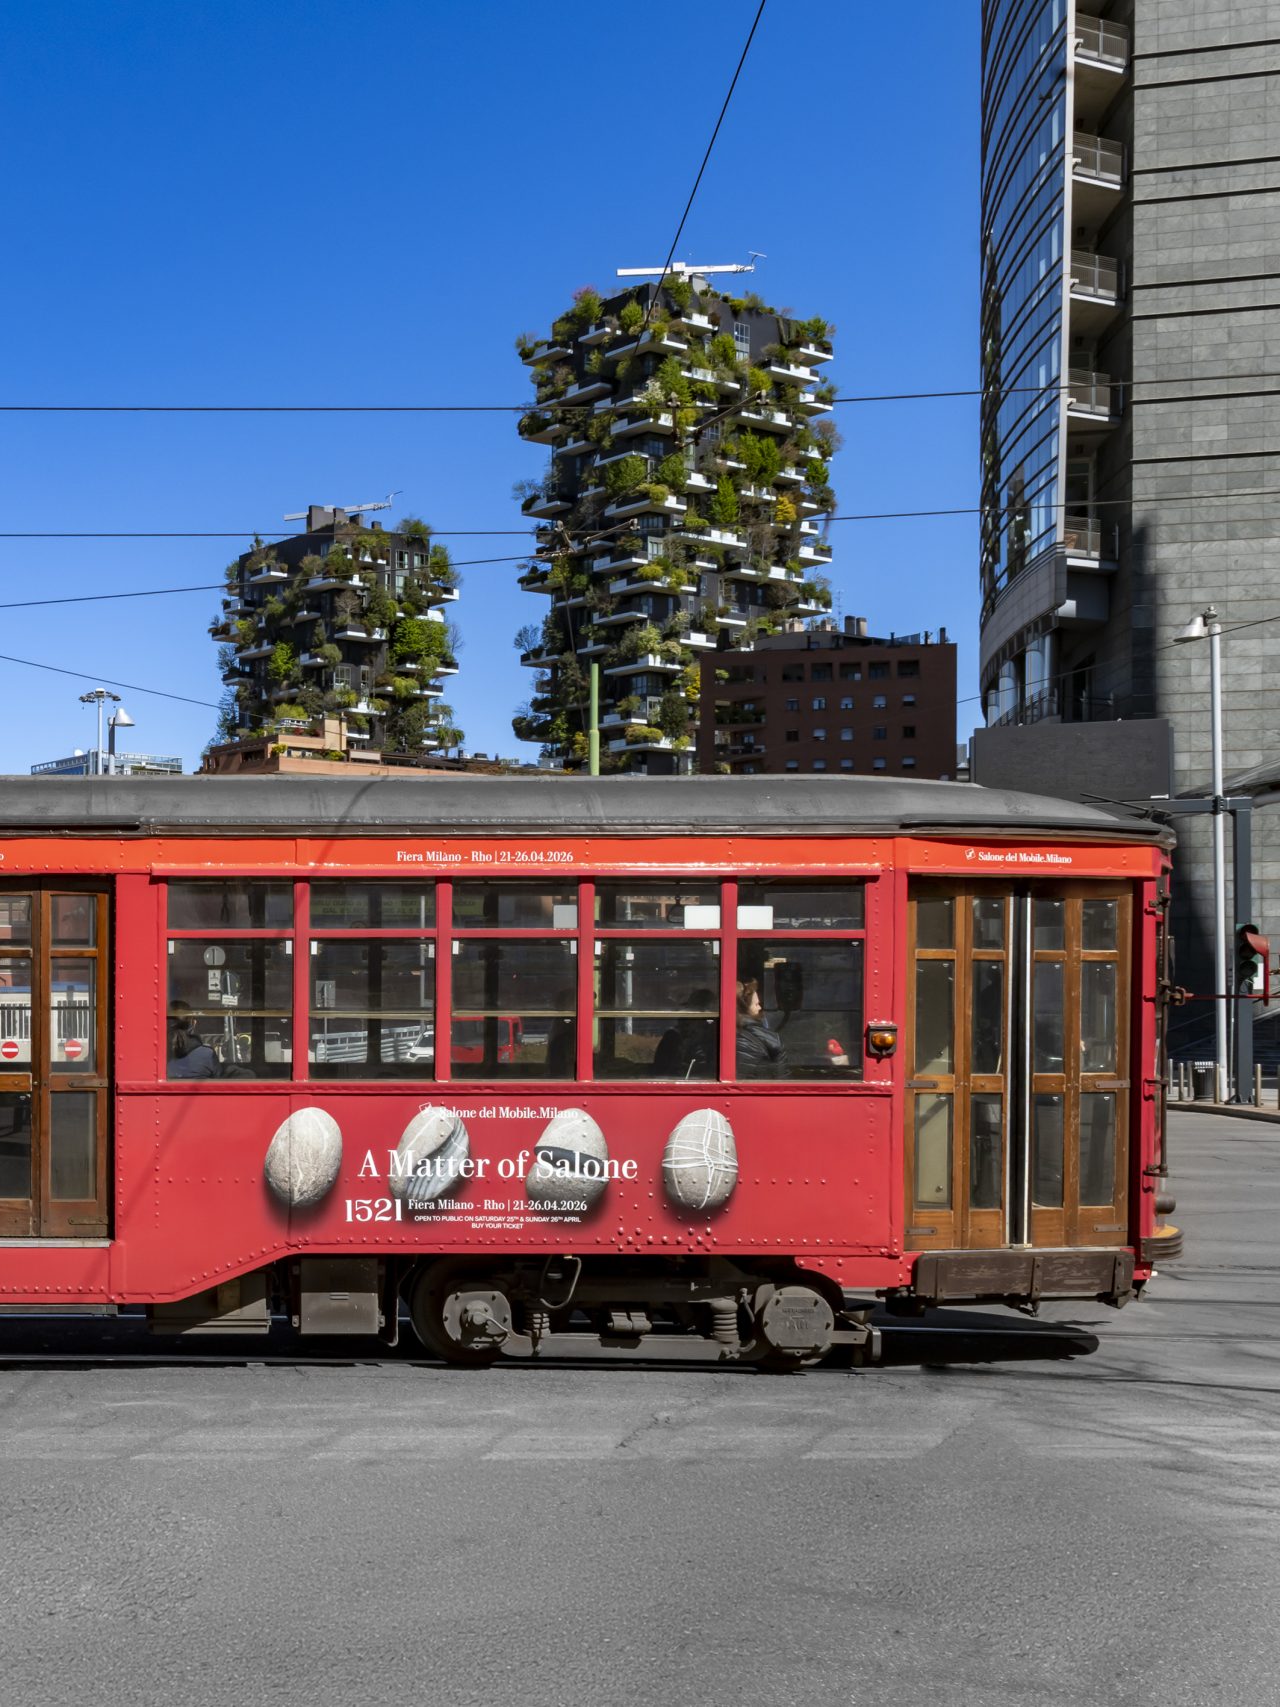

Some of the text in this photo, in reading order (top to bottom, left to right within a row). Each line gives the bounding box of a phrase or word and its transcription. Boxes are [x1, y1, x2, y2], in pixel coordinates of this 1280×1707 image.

[396, 851, 423, 862] Fiera
[426, 850, 462, 862] Milano
[471, 851, 492, 862] Rho
[500, 851, 574, 862] 21-26.04.2026
[978, 851, 1072, 864] Salone del Mobile.Milano
[439, 1106, 579, 1119] Salone del Mobile.Milano
[357, 1149, 638, 1180] A Matter of Salone
[345, 1198, 402, 1222] 1521
[408, 1199, 435, 1210] Fiera
[437, 1199, 474, 1210] Milano
[483, 1200, 505, 1211] Rho
[513, 1200, 588, 1211] 21-26.04.2026
[474, 1215, 506, 1223] SATURDAY
[502, 1222, 524, 1230] TICKET
